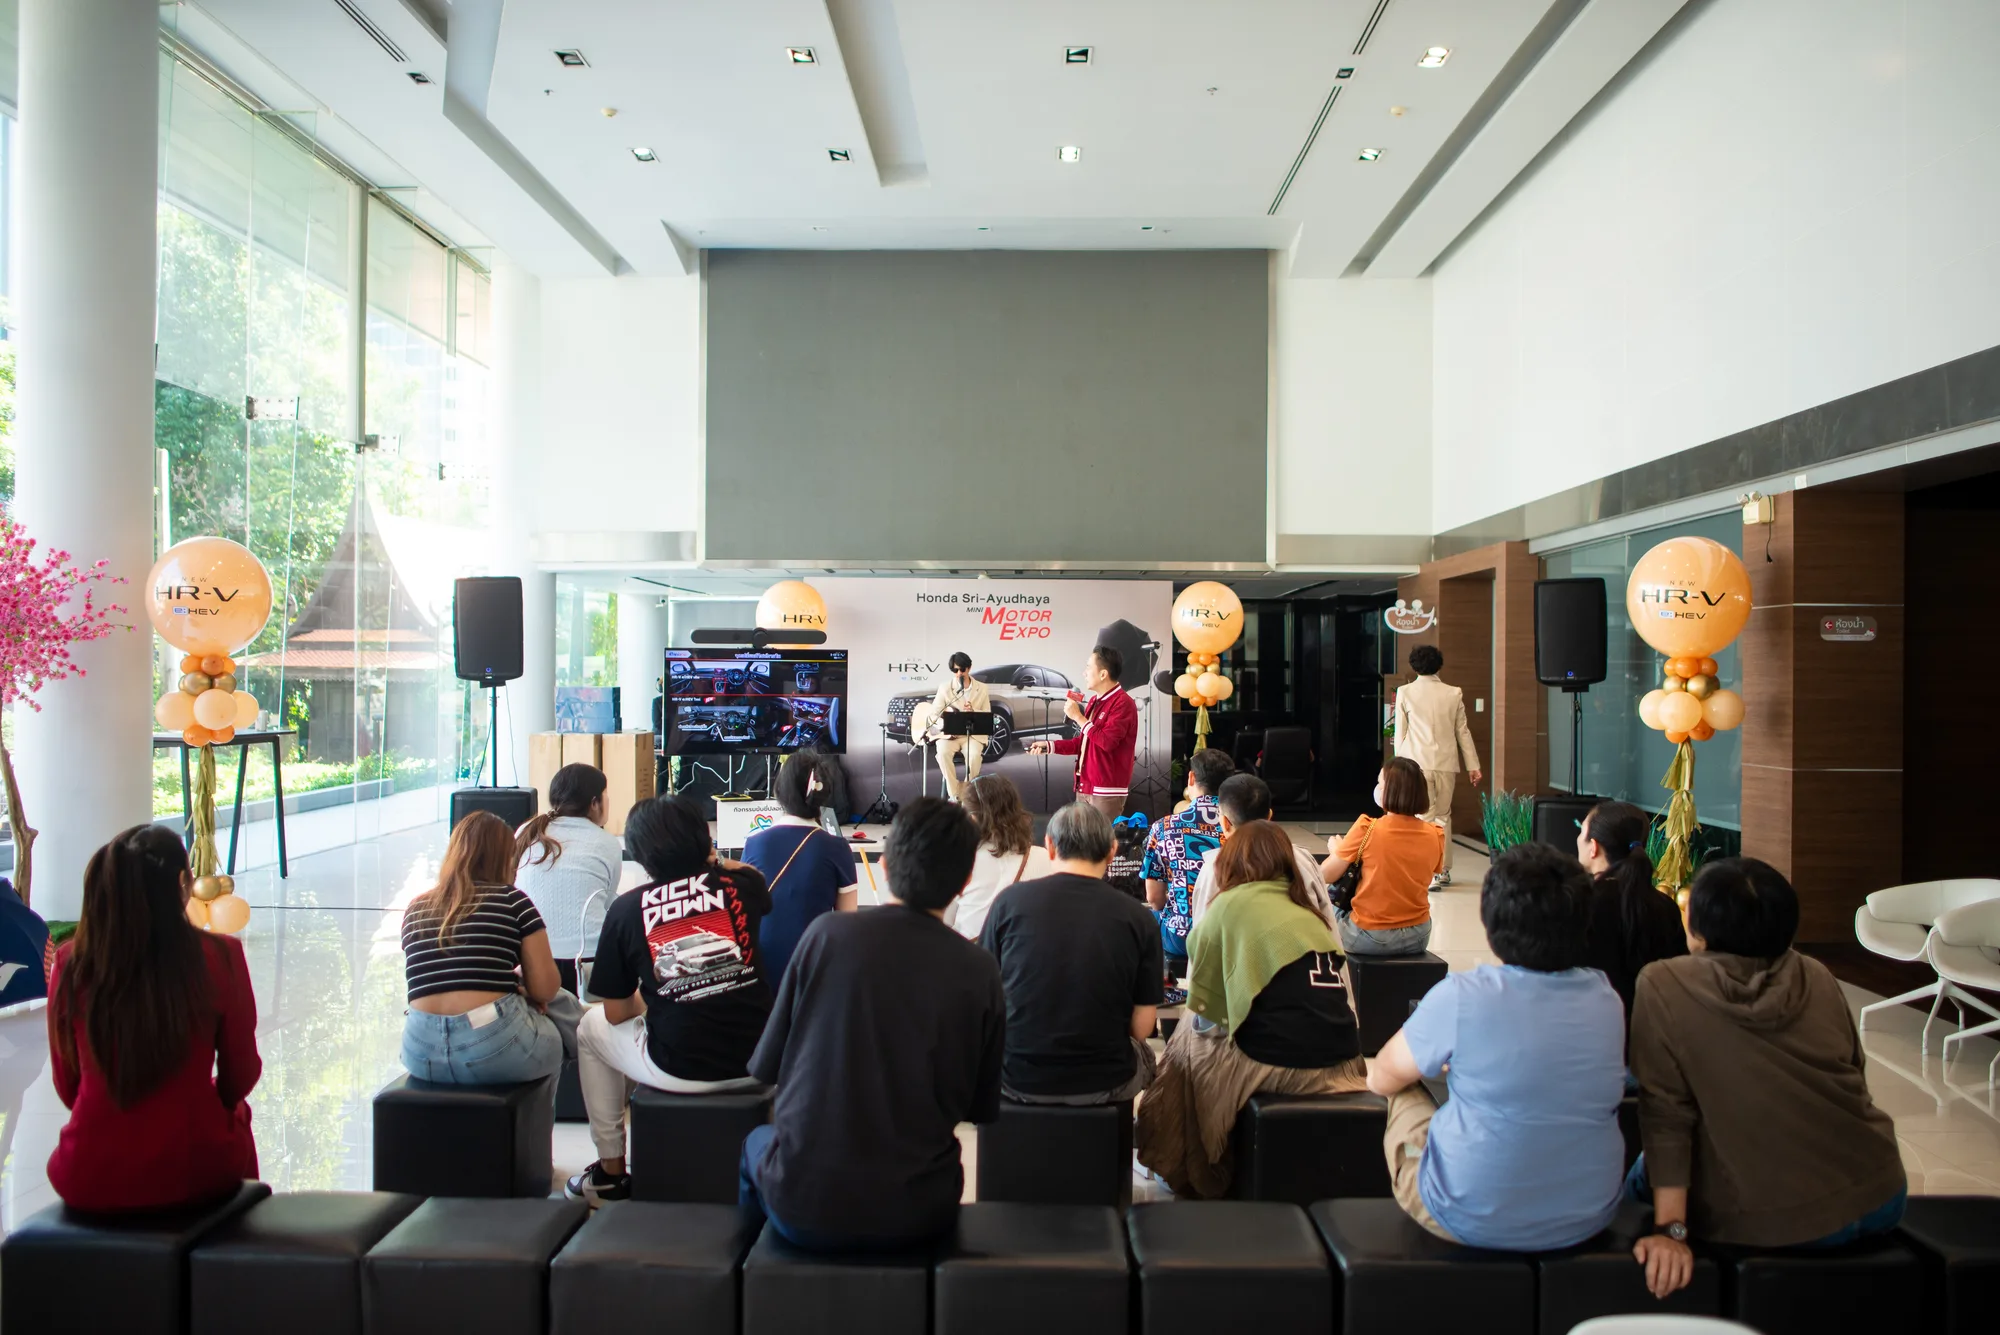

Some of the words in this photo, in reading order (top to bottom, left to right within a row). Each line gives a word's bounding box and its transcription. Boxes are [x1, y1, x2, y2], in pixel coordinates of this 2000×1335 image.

[156, 585, 239, 602] HR-V
[916, 593, 958, 603] Honda
[962, 593, 1051, 606] Sri-Ayudhaya
[1642, 589, 1726, 606] HR-V
[783, 614, 827, 624] HR-V
[981, 606, 1053, 625] MOTOR
[1182, 608, 1231, 621] HR-V
[1835, 616, 1864, 628] ห้องน้ำ
[999, 623, 1051, 640] EXPO
[888, 663, 940, 672] HR-V
[641, 873, 710, 908] KICK
[643, 889, 725, 937] DOWN
